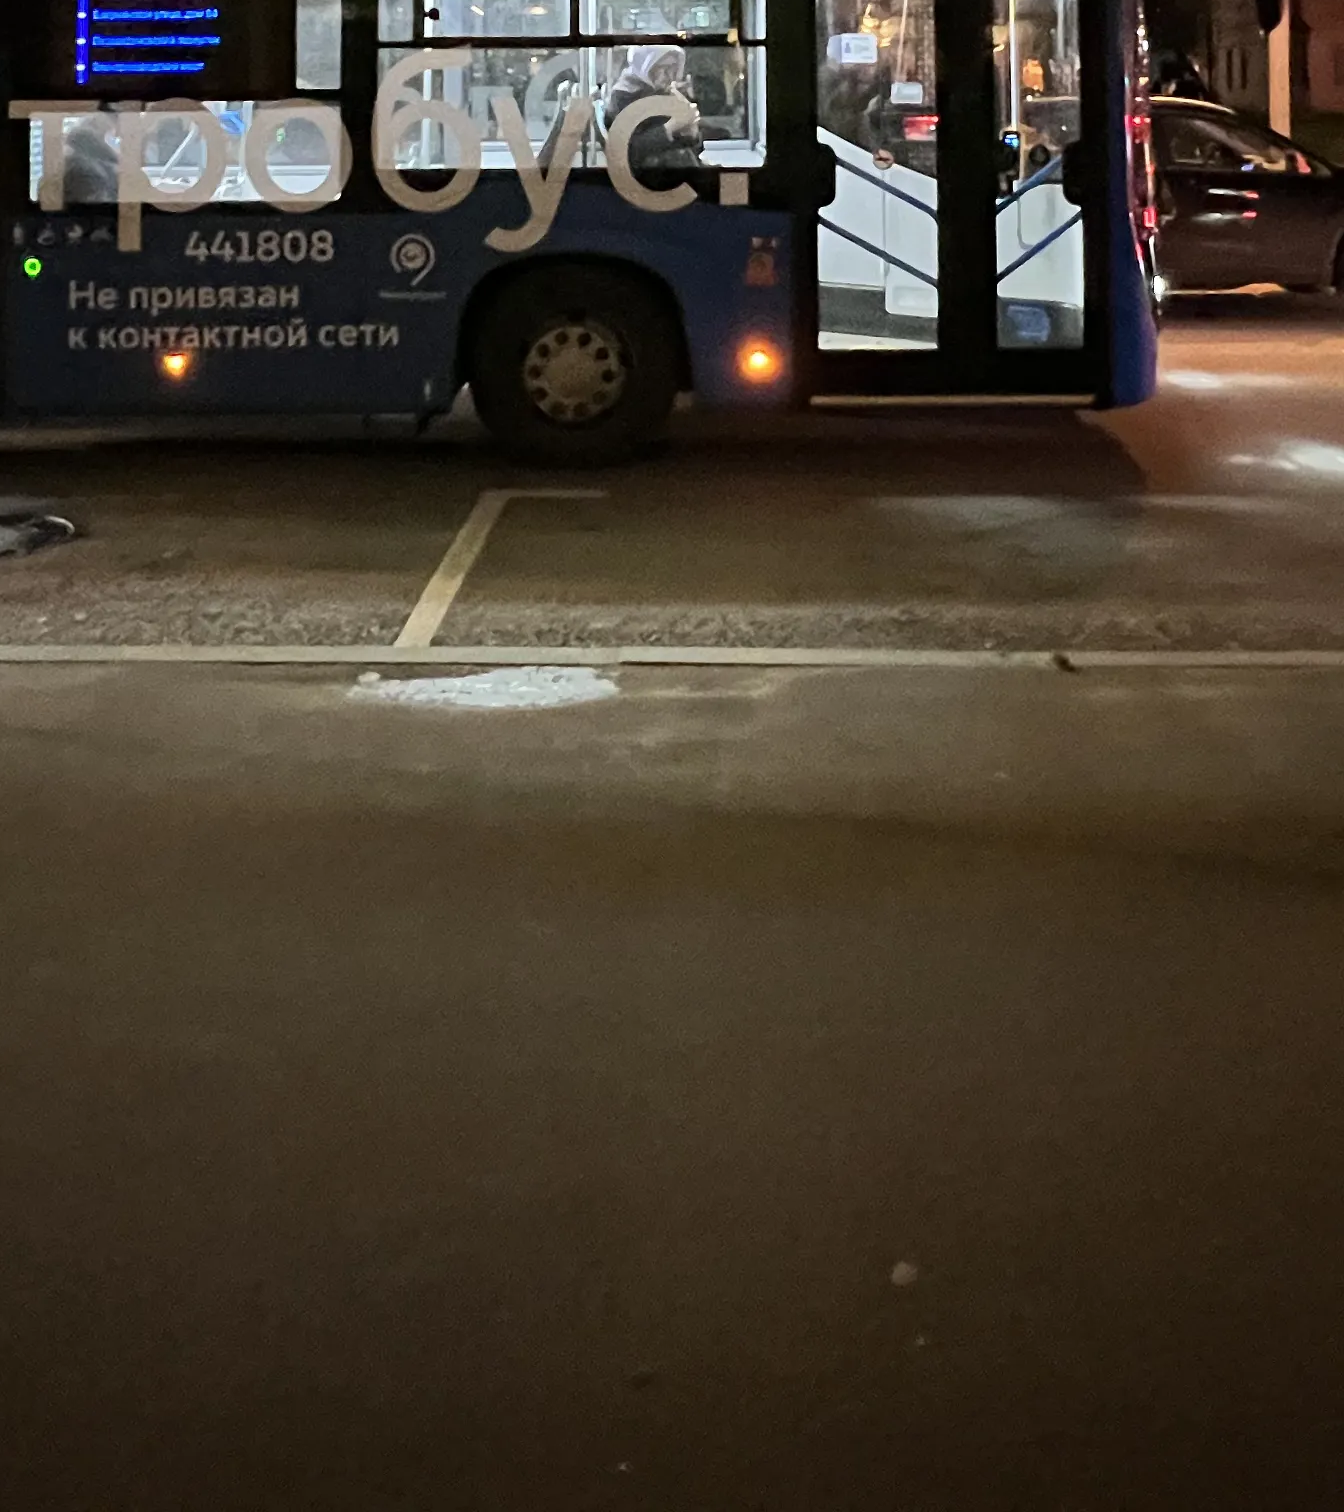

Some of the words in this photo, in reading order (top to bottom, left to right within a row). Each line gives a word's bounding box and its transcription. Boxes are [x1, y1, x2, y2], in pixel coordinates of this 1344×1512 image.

[185, 229, 335, 263] 441808
[68, 279, 119, 311] Не
[128, 283, 300, 316] привязан
[67, 325, 87, 350] к
[98, 317, 309, 350] контактной
[317, 323, 400, 348] сети
